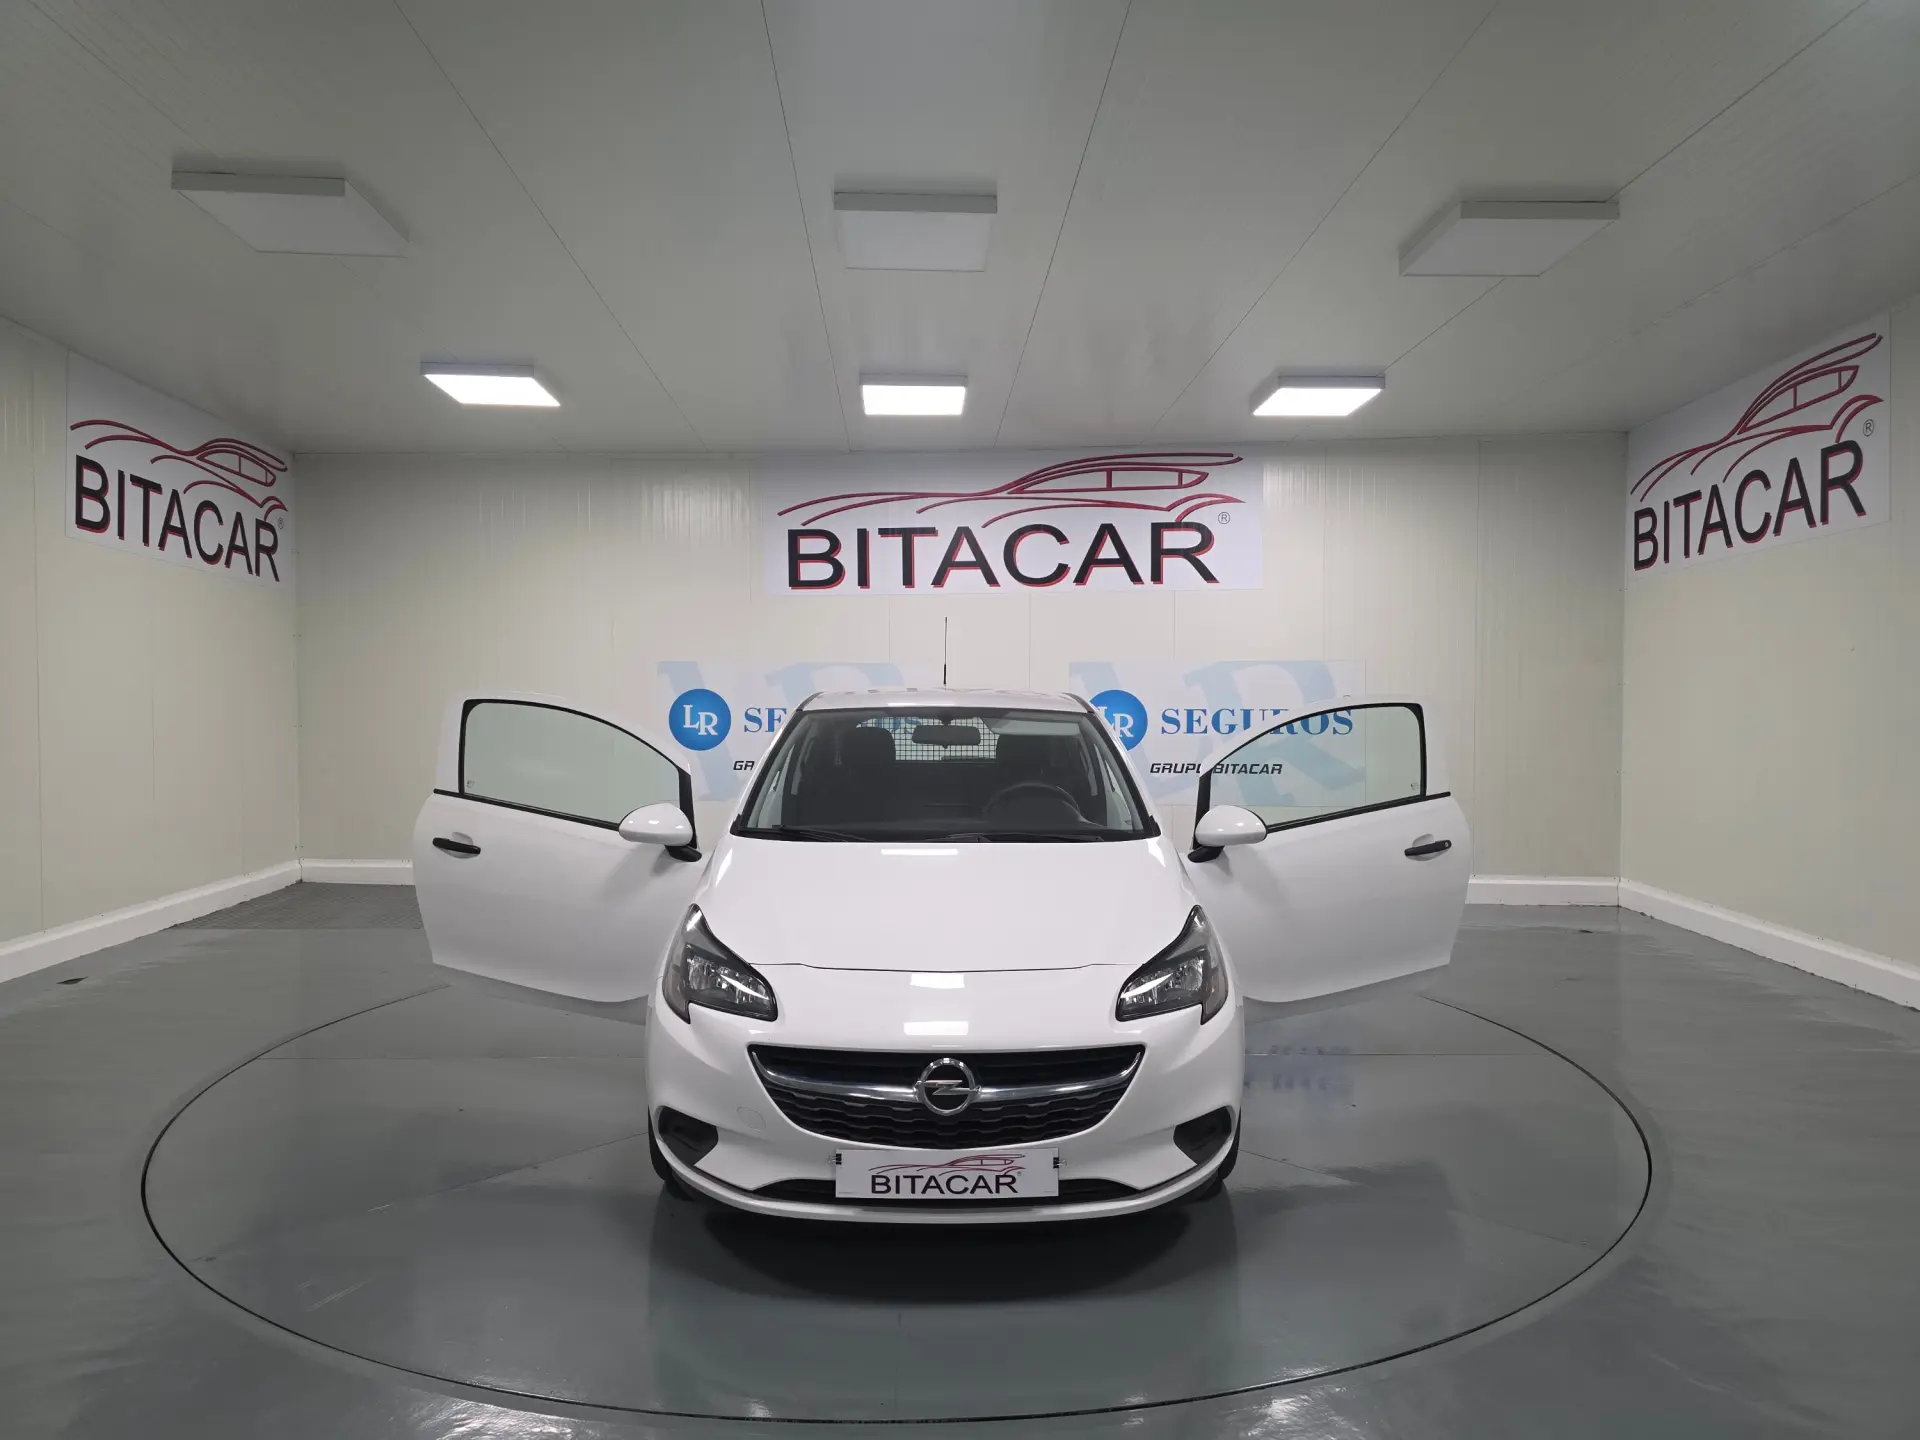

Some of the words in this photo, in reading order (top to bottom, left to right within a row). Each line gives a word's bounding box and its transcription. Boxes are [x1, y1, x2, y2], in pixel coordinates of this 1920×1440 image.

[75, 454, 280, 582] BITACAR
[1633, 439, 1867, 571] BITACAR
[787, 521, 1220, 590] BITACAR
[682, 704, 719, 736] LR
[1212, 763, 1283, 775] BITACAR
[871, 1174, 1018, 1195] BITACAR
